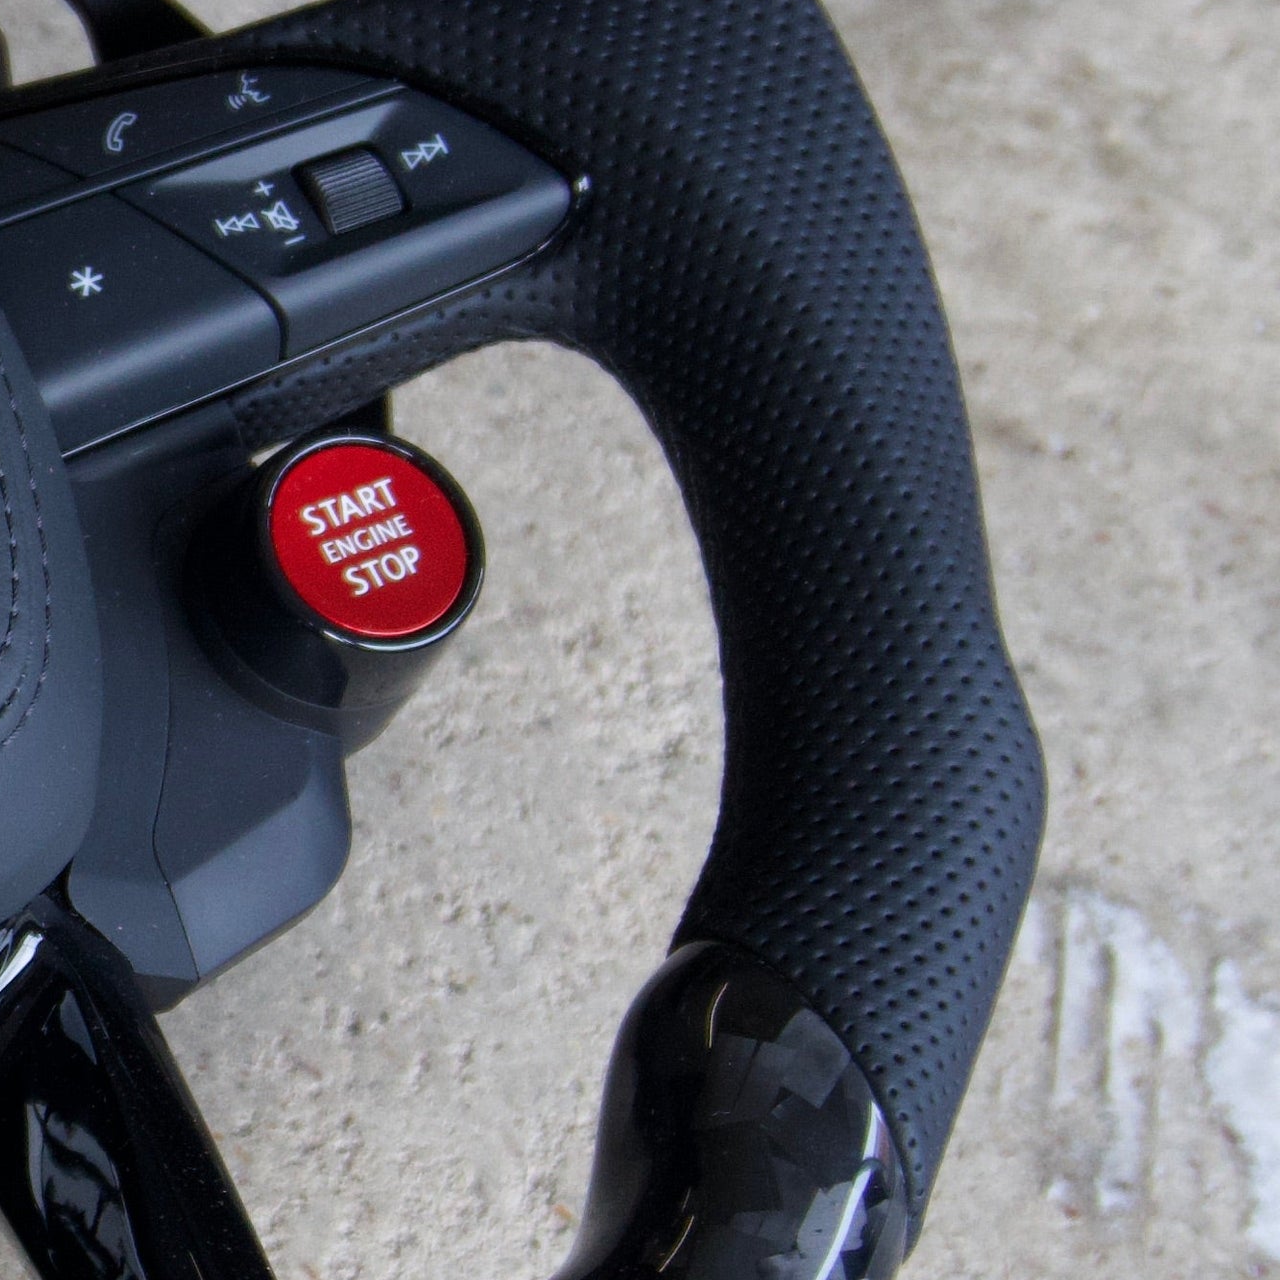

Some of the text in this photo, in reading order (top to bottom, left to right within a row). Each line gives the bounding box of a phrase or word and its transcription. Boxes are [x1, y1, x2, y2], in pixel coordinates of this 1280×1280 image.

[301, 478, 396, 536] START
[321, 515, 413, 563] ENGINE
[344, 546, 420, 596] STOP
